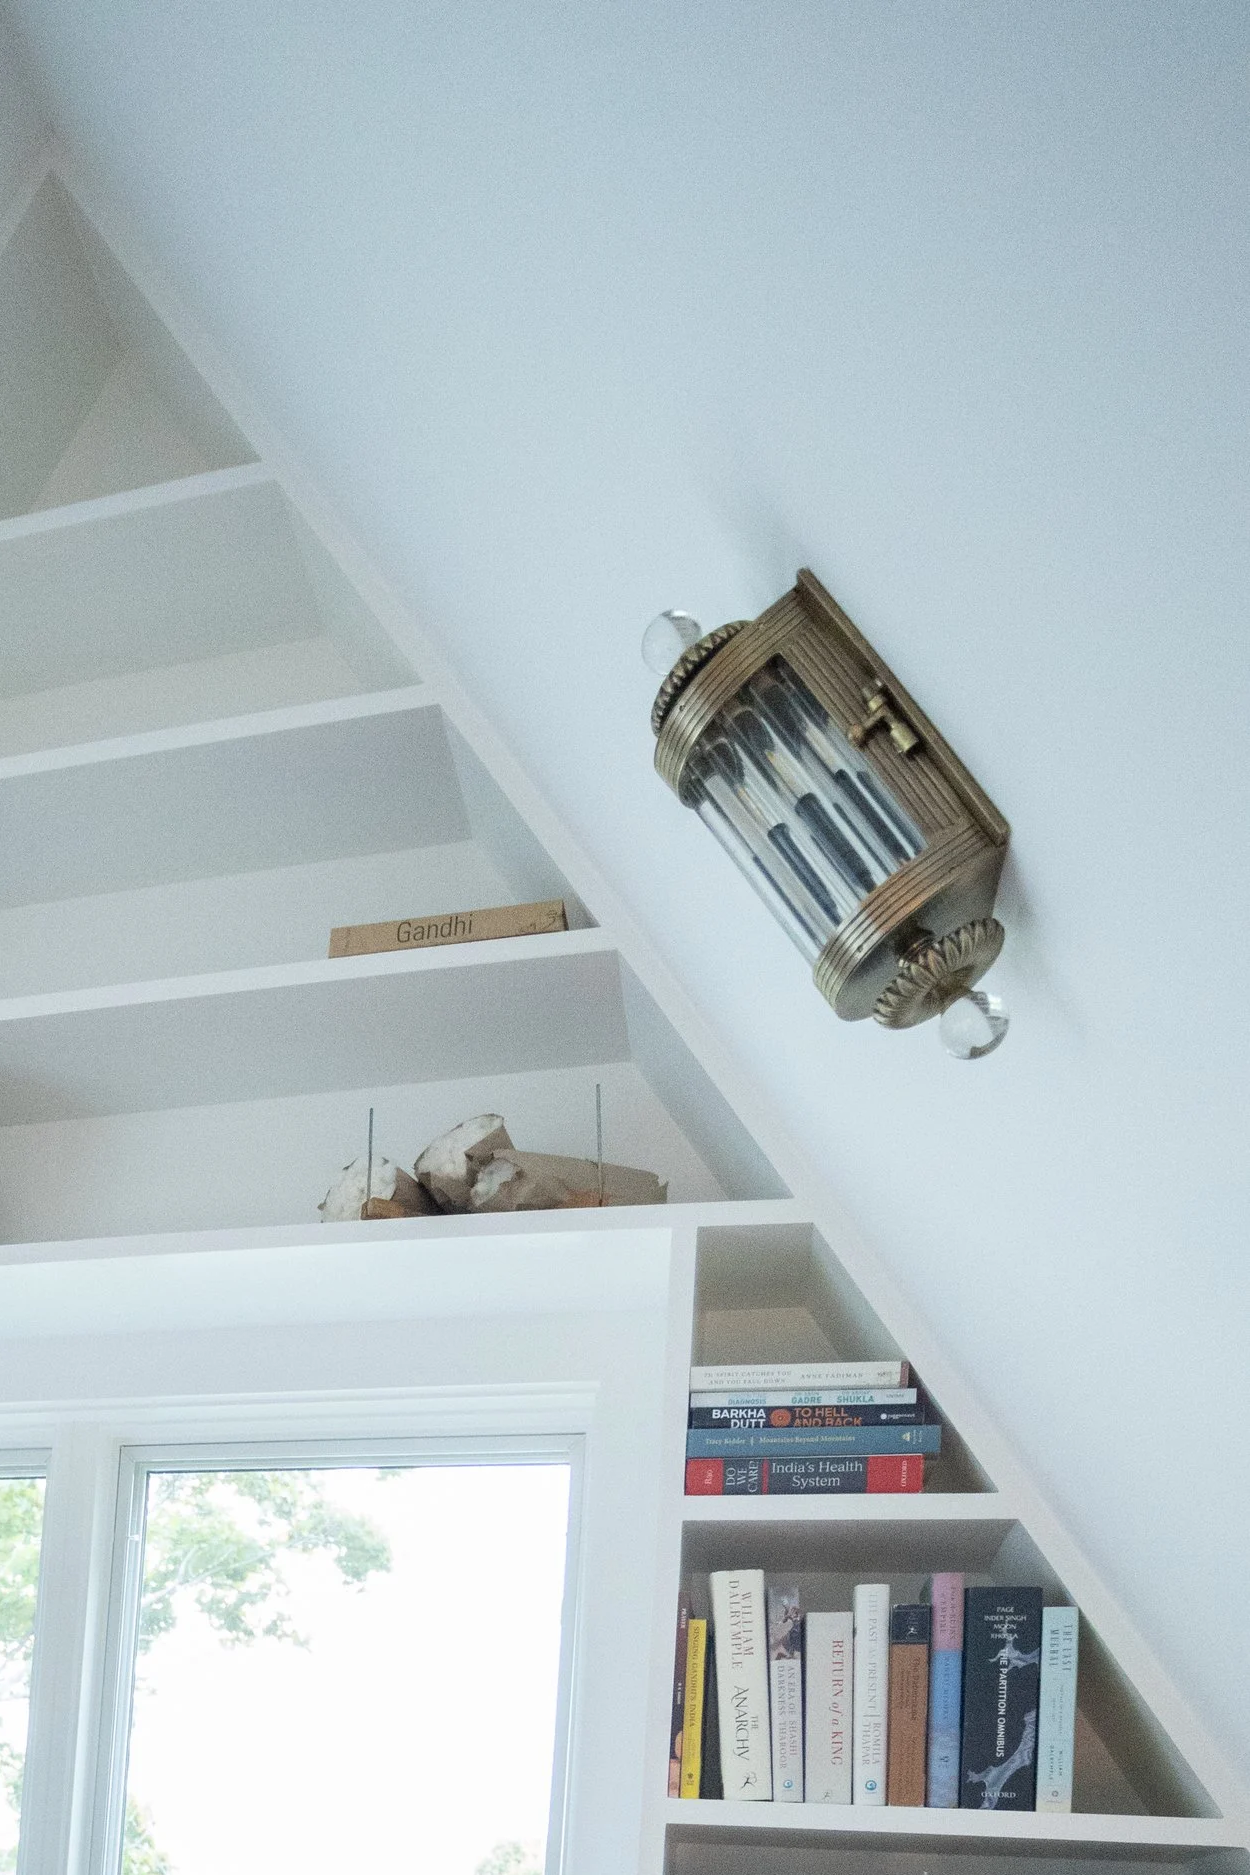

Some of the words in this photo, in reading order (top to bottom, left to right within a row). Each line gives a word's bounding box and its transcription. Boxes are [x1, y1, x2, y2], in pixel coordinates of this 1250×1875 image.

[397, 914, 473, 943] Gandhi
[791, 1396, 822, 1404] GADRE
[794, 1408, 812, 1418] TO
[815, 1407, 848, 1417] HELL
[837, 1395, 874, 1403] SHUKLA
[712, 1409, 766, 1419] BARKHA
[730, 1419, 766, 1428] DUTT
[794, 1418, 822, 1427] AND
[825, 1417, 862, 1426] BACK
[726, 1467, 736, 1485] DO
[738, 1468, 747, 1485] WE
[772, 1462, 815, 1473] India's
[818, 1461, 863, 1472] Health
[792, 1475, 840, 1489] System
[728, 1580, 742, 1669] DALRYMPLE
[741, 1592, 754, 1656] WILLIAM
[831, 1640, 844, 1697] RETURN
[777, 1665, 787, 1715] DARKNESS
[998, 1671, 1008, 1714] PARTITION
[730, 1686, 750, 1760] ANARCHY
[750, 1716, 759, 1730] THE
[829, 1703, 843, 1714] of
[779, 1721, 789, 1769] THAROOR
[789, 1721, 798, 1757] SHASHI
[830, 1731, 844, 1765] KING
[862, 1722, 872, 1765] THAPAR
[870, 1722, 881, 1765] ROMILA
[996, 1717, 1006, 1757] OMNIBUS
